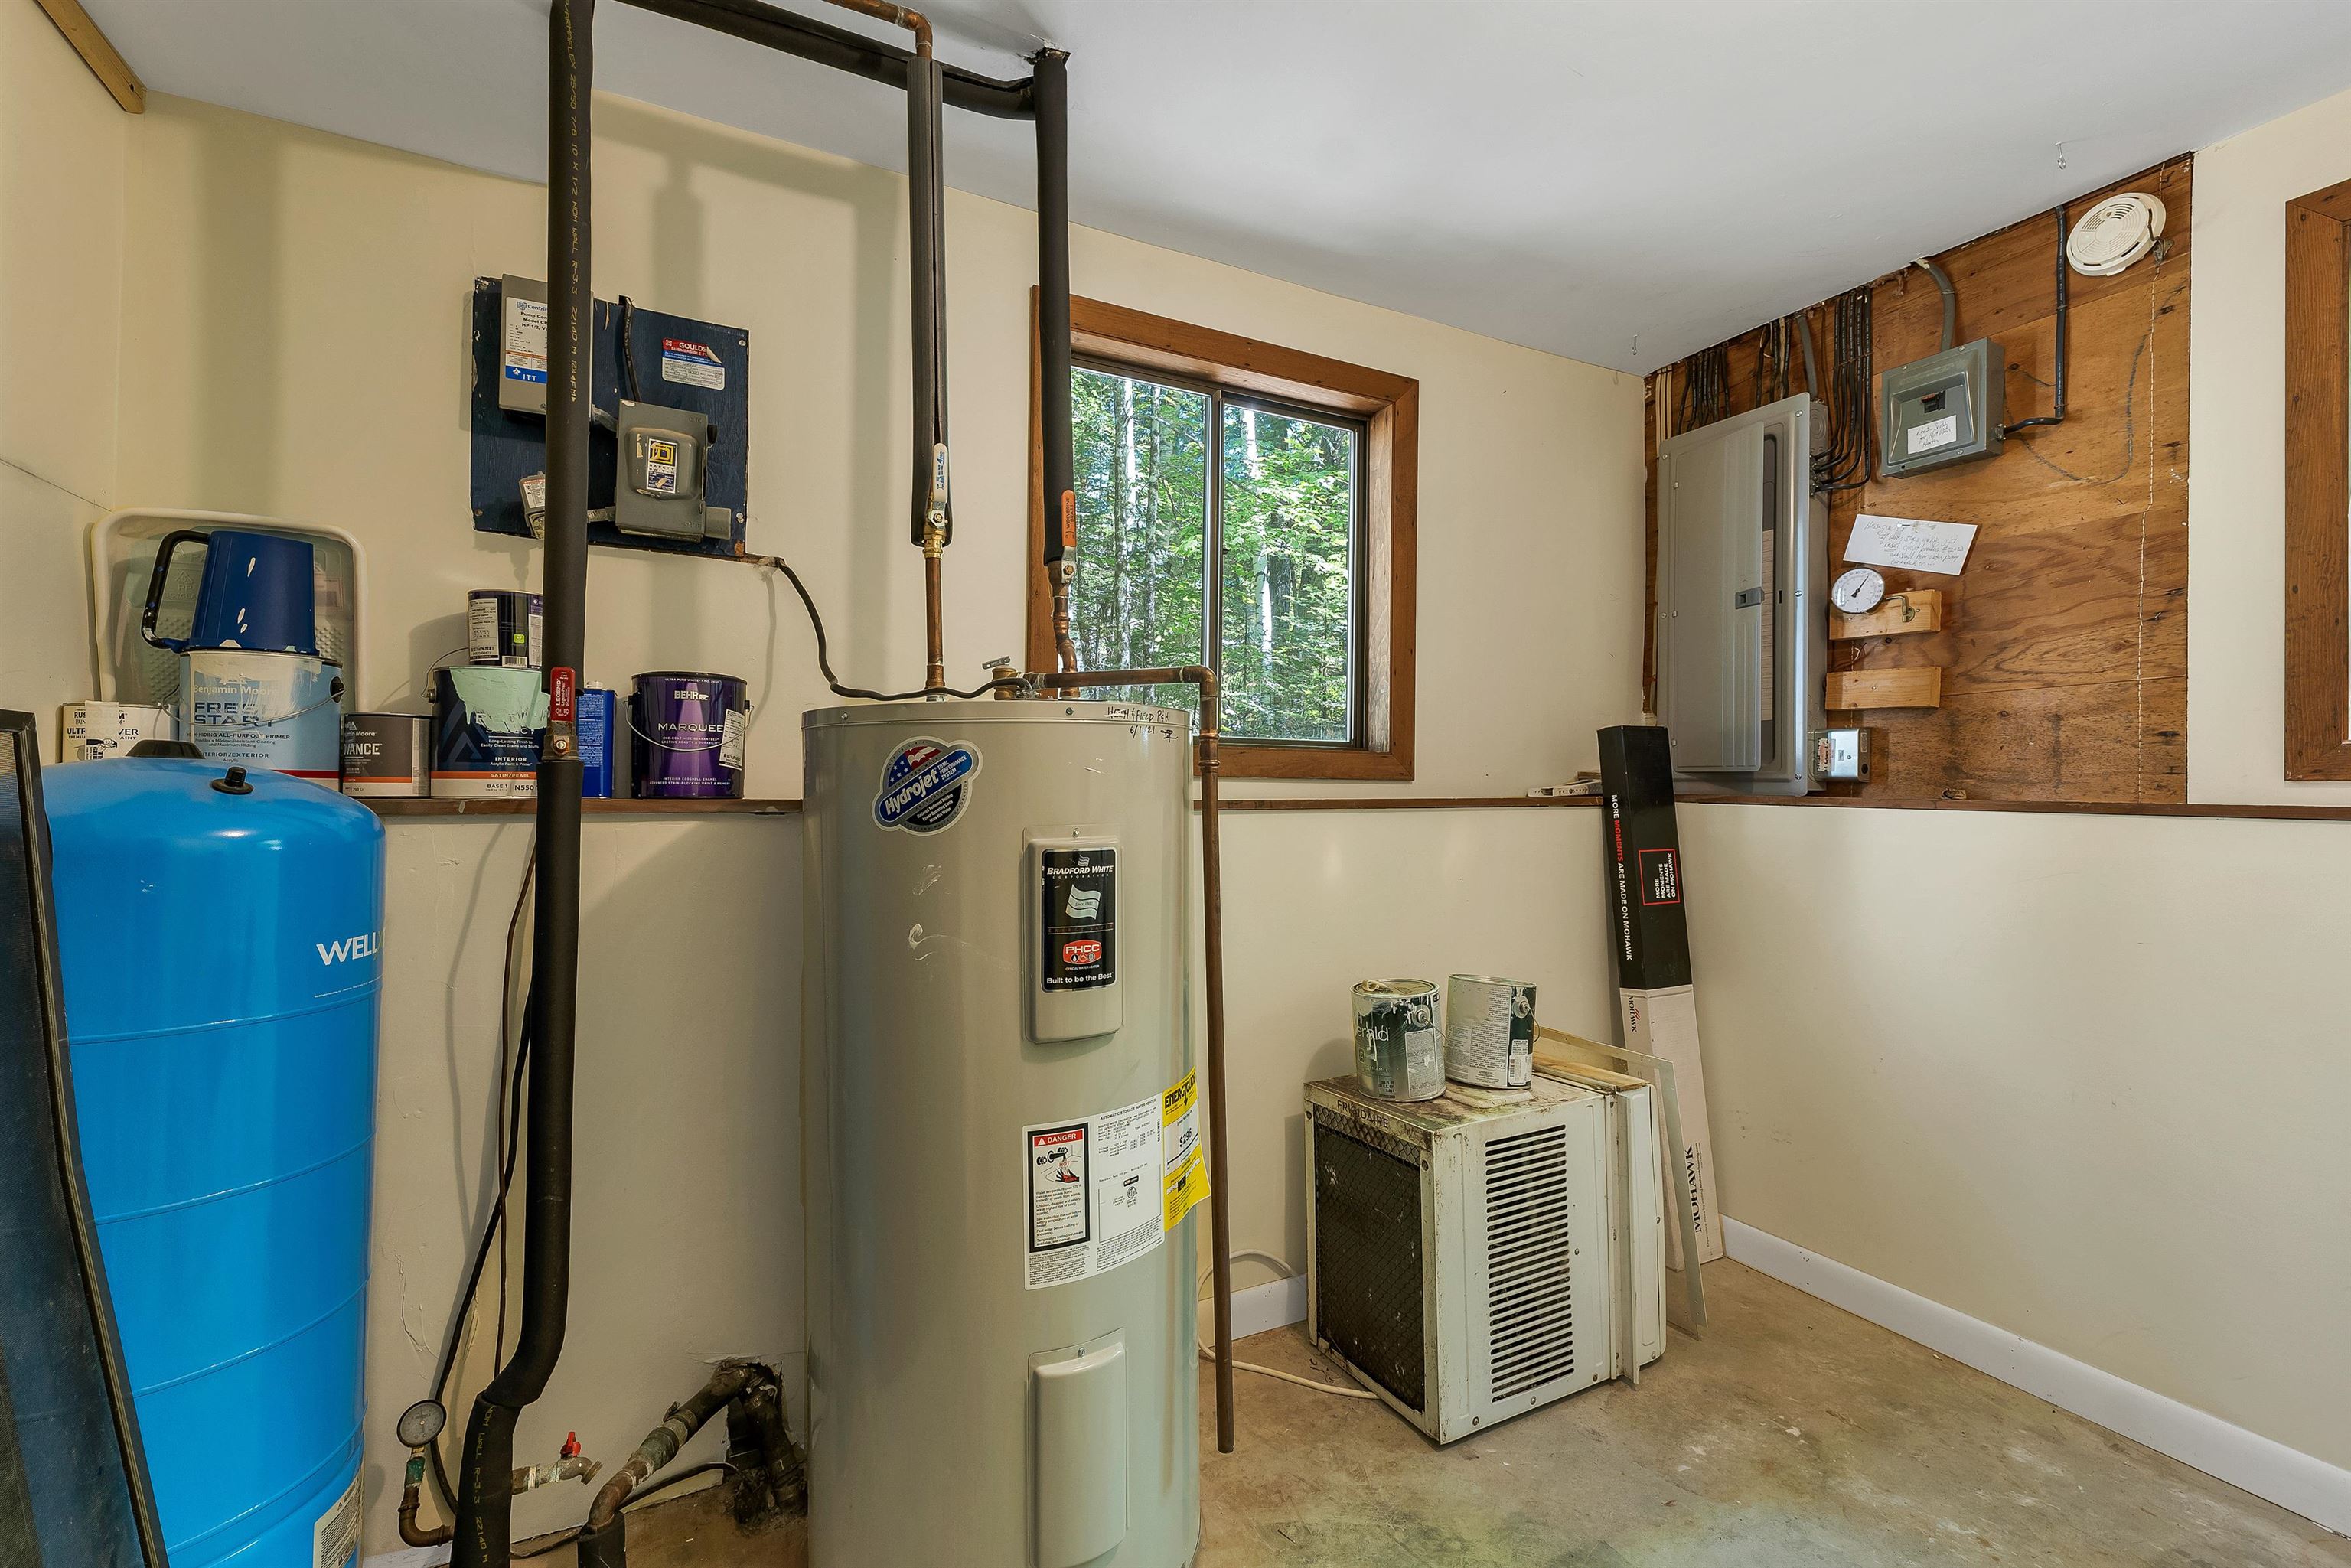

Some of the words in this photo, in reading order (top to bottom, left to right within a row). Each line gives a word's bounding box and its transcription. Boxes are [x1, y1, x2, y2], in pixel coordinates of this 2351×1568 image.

[679, 342, 707, 352] GOULDS
[194, 685, 237, 695] Benjamin
[674, 690, 698, 699] BEHR
[658, 723, 723, 732] MARQUEE
[937, 761, 949, 770] TOTAL
[940, 755, 967, 774] PERFORMANCE
[941, 768, 957, 780] SYSTEM
[885, 769, 939, 815] Hydrojet
[1614, 820, 1623, 862] MOMENTS
[1671, 886, 1676, 898] ON
[1622, 906, 1629, 919] ON
[1623, 921, 1632, 960] MOHAWK
[1065, 944, 1100, 954] PHCC
[1628, 996, 1636, 1032] MOHAWK
[1146, 1099, 1156, 1108] HEATER
[1337, 1100, 1389, 1129] FRIGIDAIRE
[1048, 1133, 1077, 1143] DANGER
[1179, 1127, 1192, 1148] $296
[482, 1406, 496, 1426] NOM
[475, 1433, 485, 1459] WALL
[475, 1517, 487, 1550] 22140
[482, 1554, 488, 1563] M
